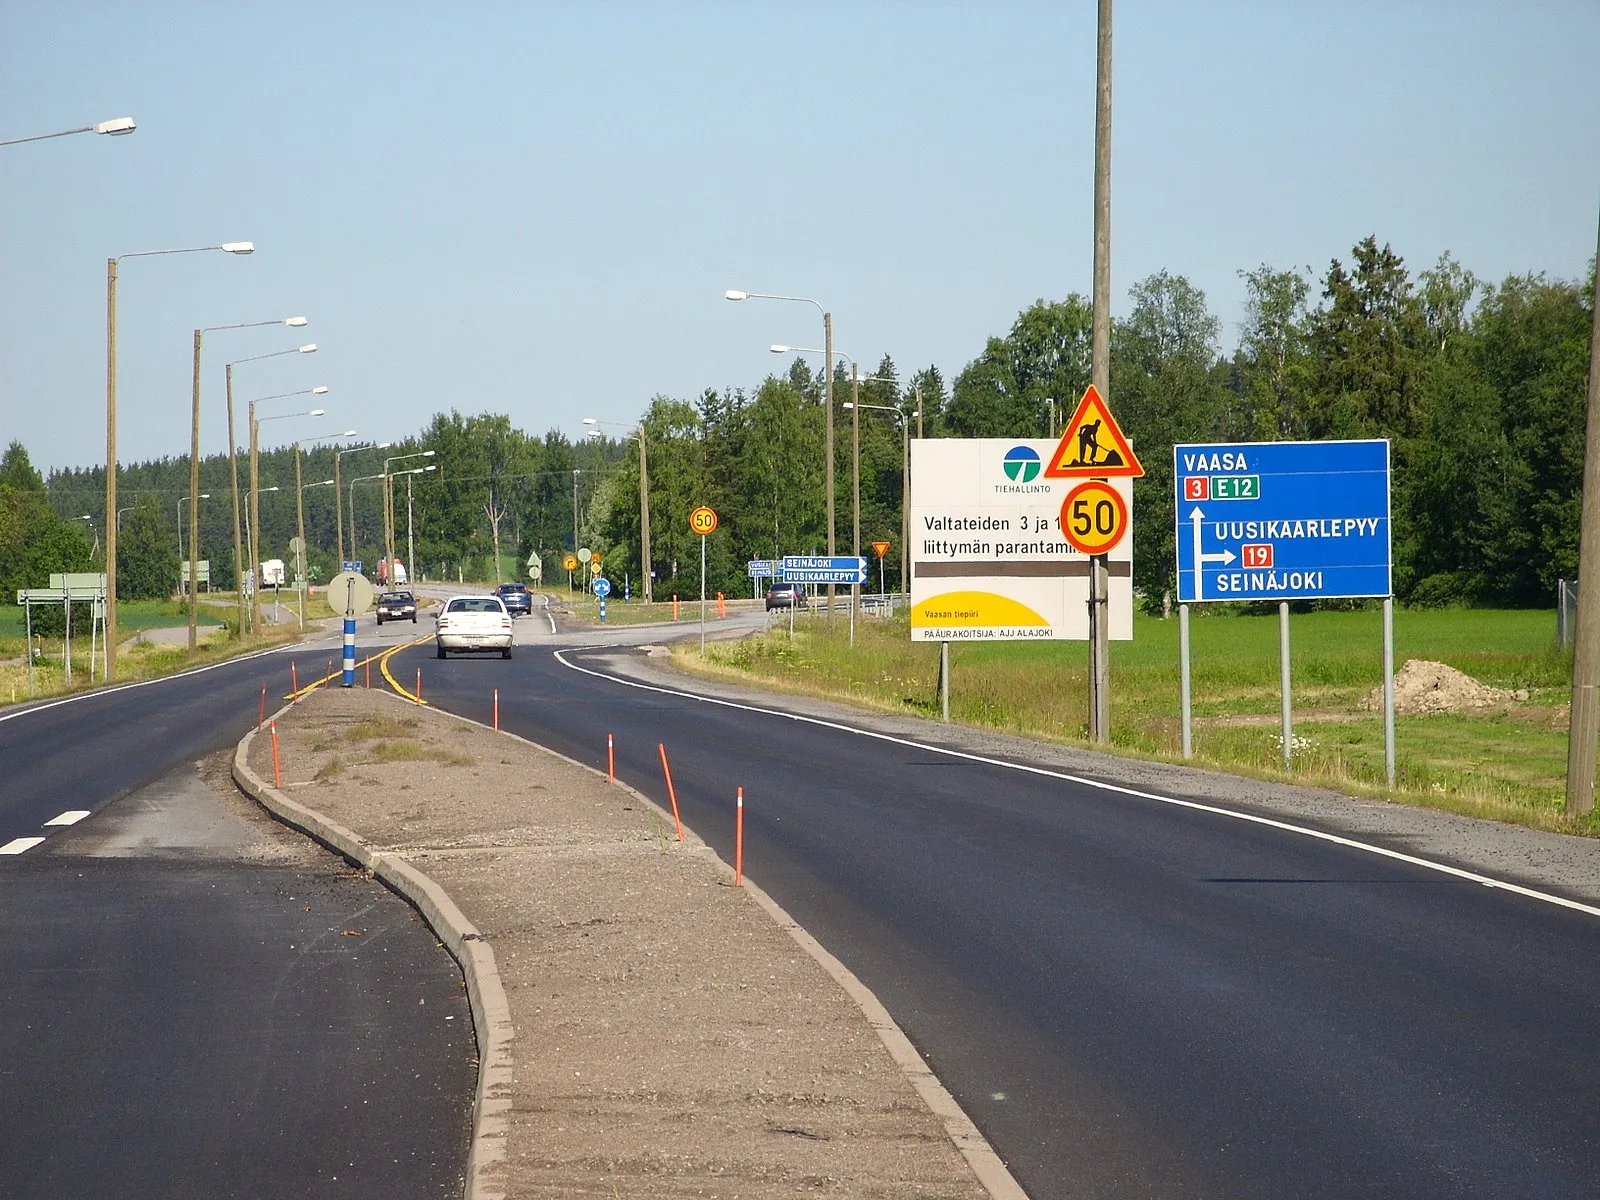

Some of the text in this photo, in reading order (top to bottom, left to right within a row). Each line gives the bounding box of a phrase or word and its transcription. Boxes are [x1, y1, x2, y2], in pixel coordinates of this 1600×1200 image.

[1183, 452, 1248, 471] VAASA
[995, 485, 1051, 494] TIEHALLINTO
[1191, 479, 1202, 497] 3
[696, 514, 712, 527] 50
[924, 516, 1061, 533] Valtateiden 3 ja 1
[1073, 500, 1115, 536] 50
[1215, 518, 1379, 540] UUSIKAARLEPYY
[924, 539, 1081, 557] liittymän parantami
[1248, 547, 1268, 566] 19
[786, 558, 832, 568] SEINÄJOKI
[786, 572, 855, 581] UUSIKAARLEPYY
[1216, 570, 1324, 592] SEINÄJOKI
[924, 610, 979, 619] Vaasan tiepiiri
[924, 628, 1053, 639] PÄÄURAKOITSIJA: AJJ ALAJOKI
